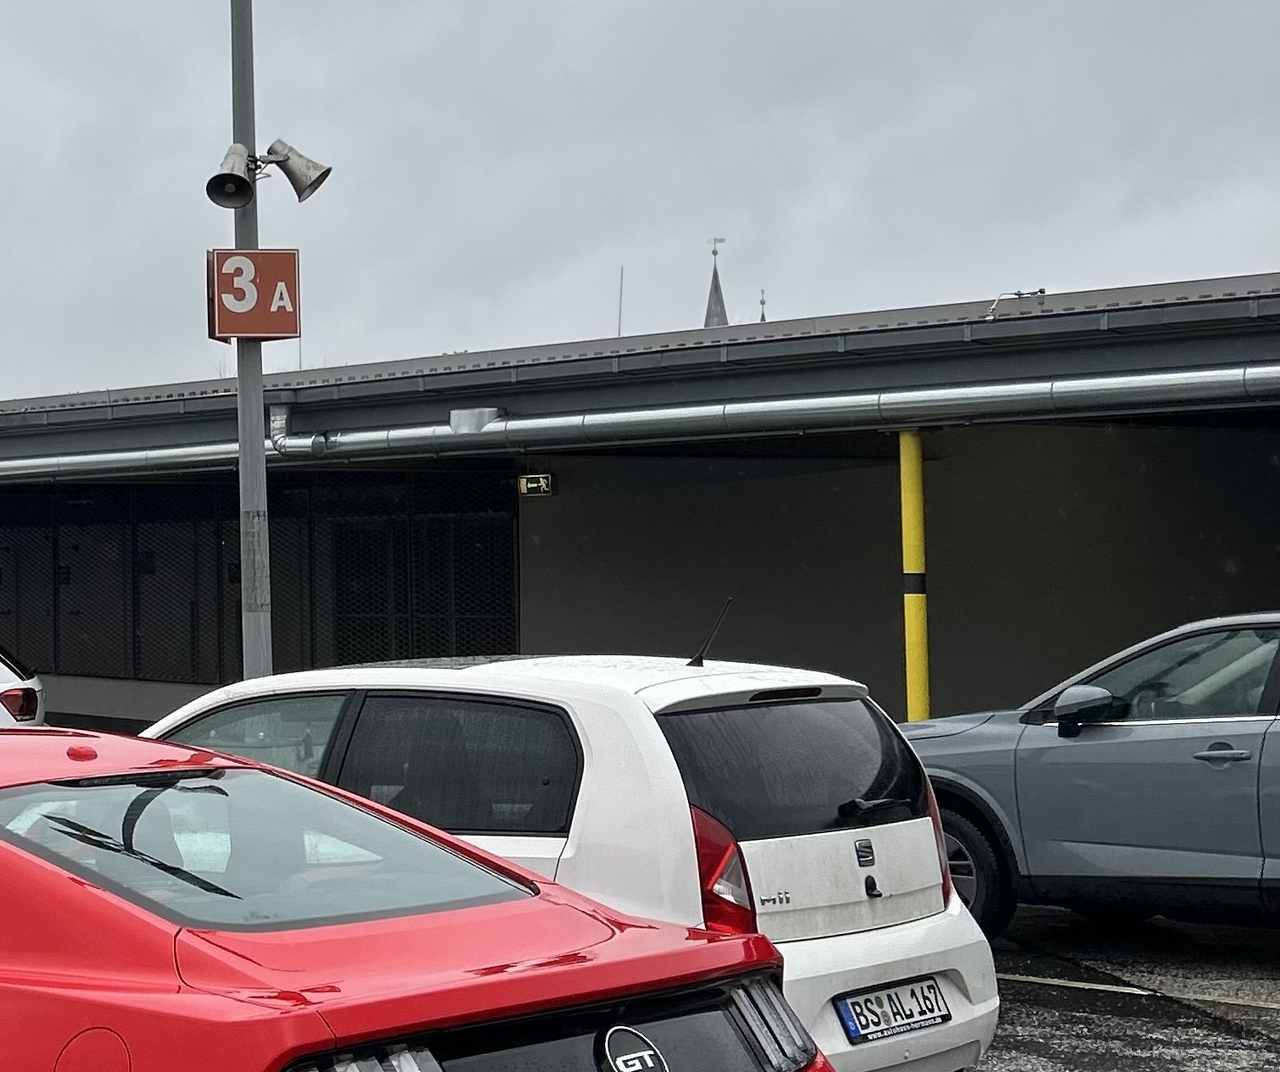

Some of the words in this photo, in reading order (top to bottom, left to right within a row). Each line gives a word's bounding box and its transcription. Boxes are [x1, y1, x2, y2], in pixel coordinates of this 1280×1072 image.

[221, 255, 258, 313] 3
[270, 281, 294, 312] A
[850, 997, 881, 1030] BS
[886, 992, 915, 1022] AL
[910, 984, 942, 1016] 167
[615, 1050, 655, 1072] GT
